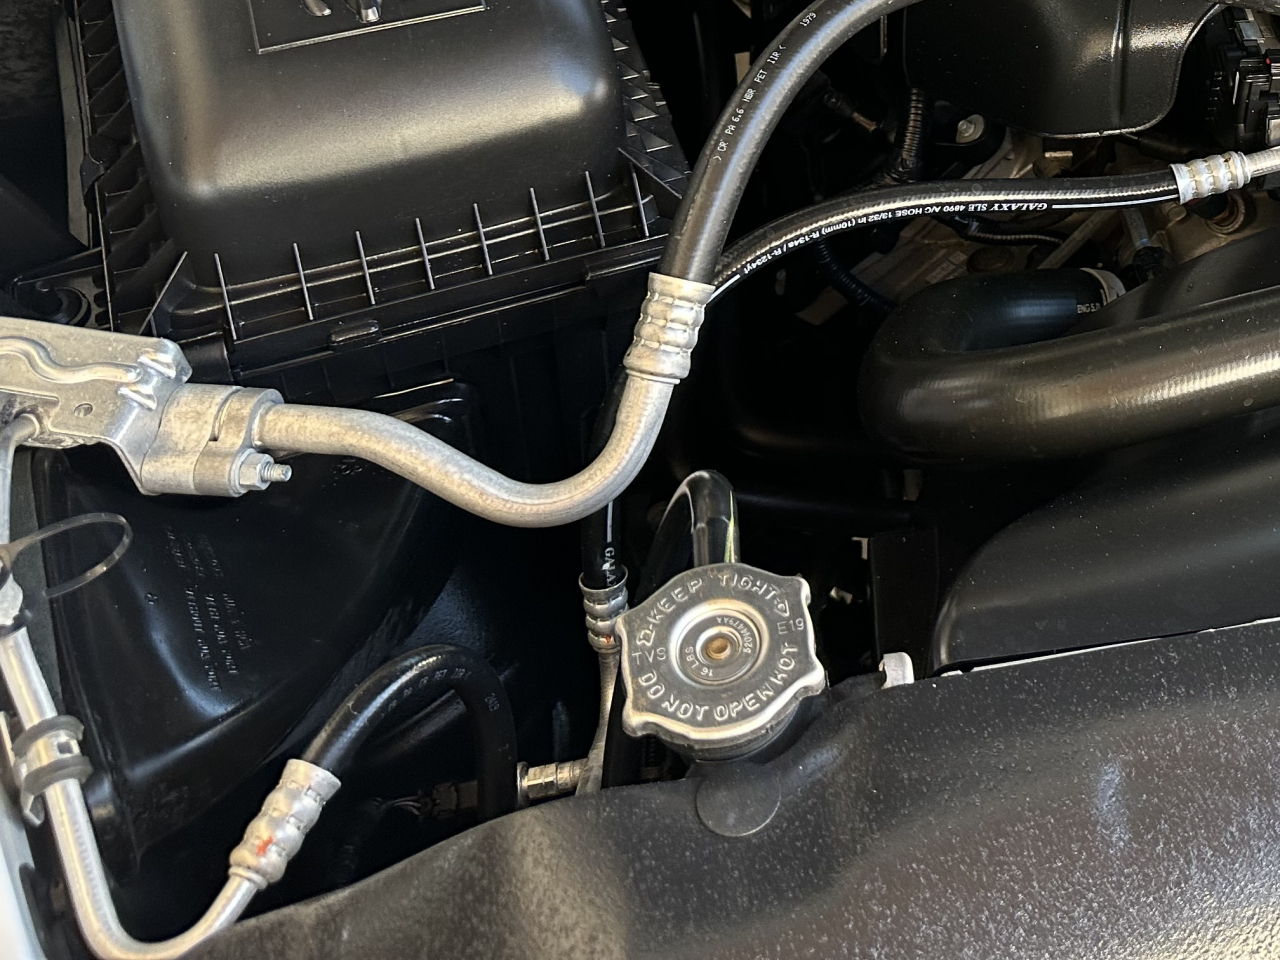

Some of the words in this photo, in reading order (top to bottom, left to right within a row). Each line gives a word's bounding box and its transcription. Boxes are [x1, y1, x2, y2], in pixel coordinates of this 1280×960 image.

[800, 12, 817, 27] 1979
[724, 124, 736, 135] PA
[731, 108, 745, 122] 6.6
[753, 69, 768, 84] PET
[895, 207, 922, 218] HOSE
[924, 205, 942, 214] A/C
[968, 203, 988, 212] SLE
[989, 202, 1048, 211] GALAXY
[868, 211, 893, 222] 13/32
[821, 219, 856, 235] (10mm)
[787, 230, 820, 248] R-134a
[743, 247, 783, 274] R-1234yf
[648, 578, 703, 624] KEEP
[718, 574, 778, 601] TIGHT
[776, 618, 805, 635] E19
[632, 647, 667, 666] TVS
[685, 646, 700, 668] LBS
[700, 667, 713, 677] 16
[638, 671, 665, 699] DO
[661, 694, 709, 721] NOT
[713, 682, 775, 721] OPEN
[770, 642, 799, 685] HOT
